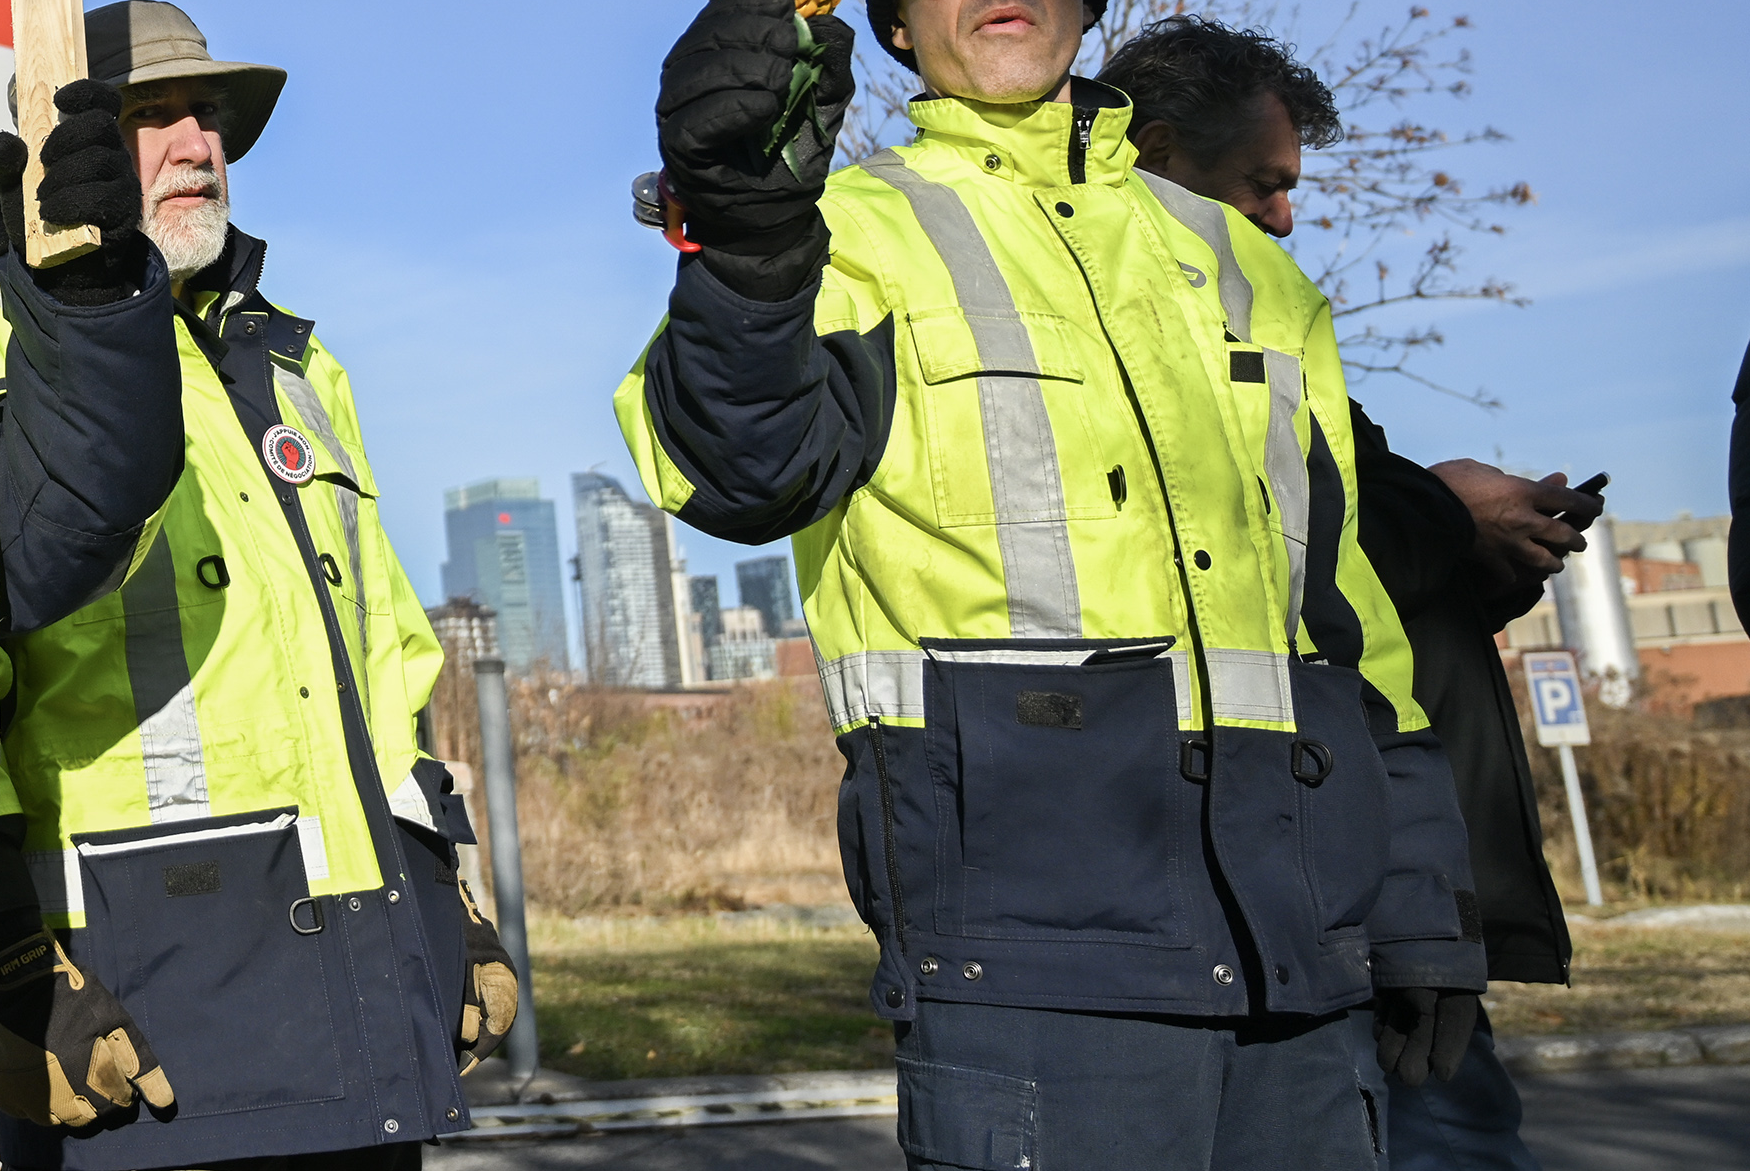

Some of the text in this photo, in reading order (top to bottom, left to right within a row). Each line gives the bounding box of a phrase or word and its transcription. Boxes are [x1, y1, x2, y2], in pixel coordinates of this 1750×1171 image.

[273, 428, 310, 450] J'APPUIE MON
[276, 465, 286, 474] DE
[285, 454, 313, 479] NÉGOCIATION
[1539, 679, 1571, 723] P
[20, 944, 47, 965] GRIP
